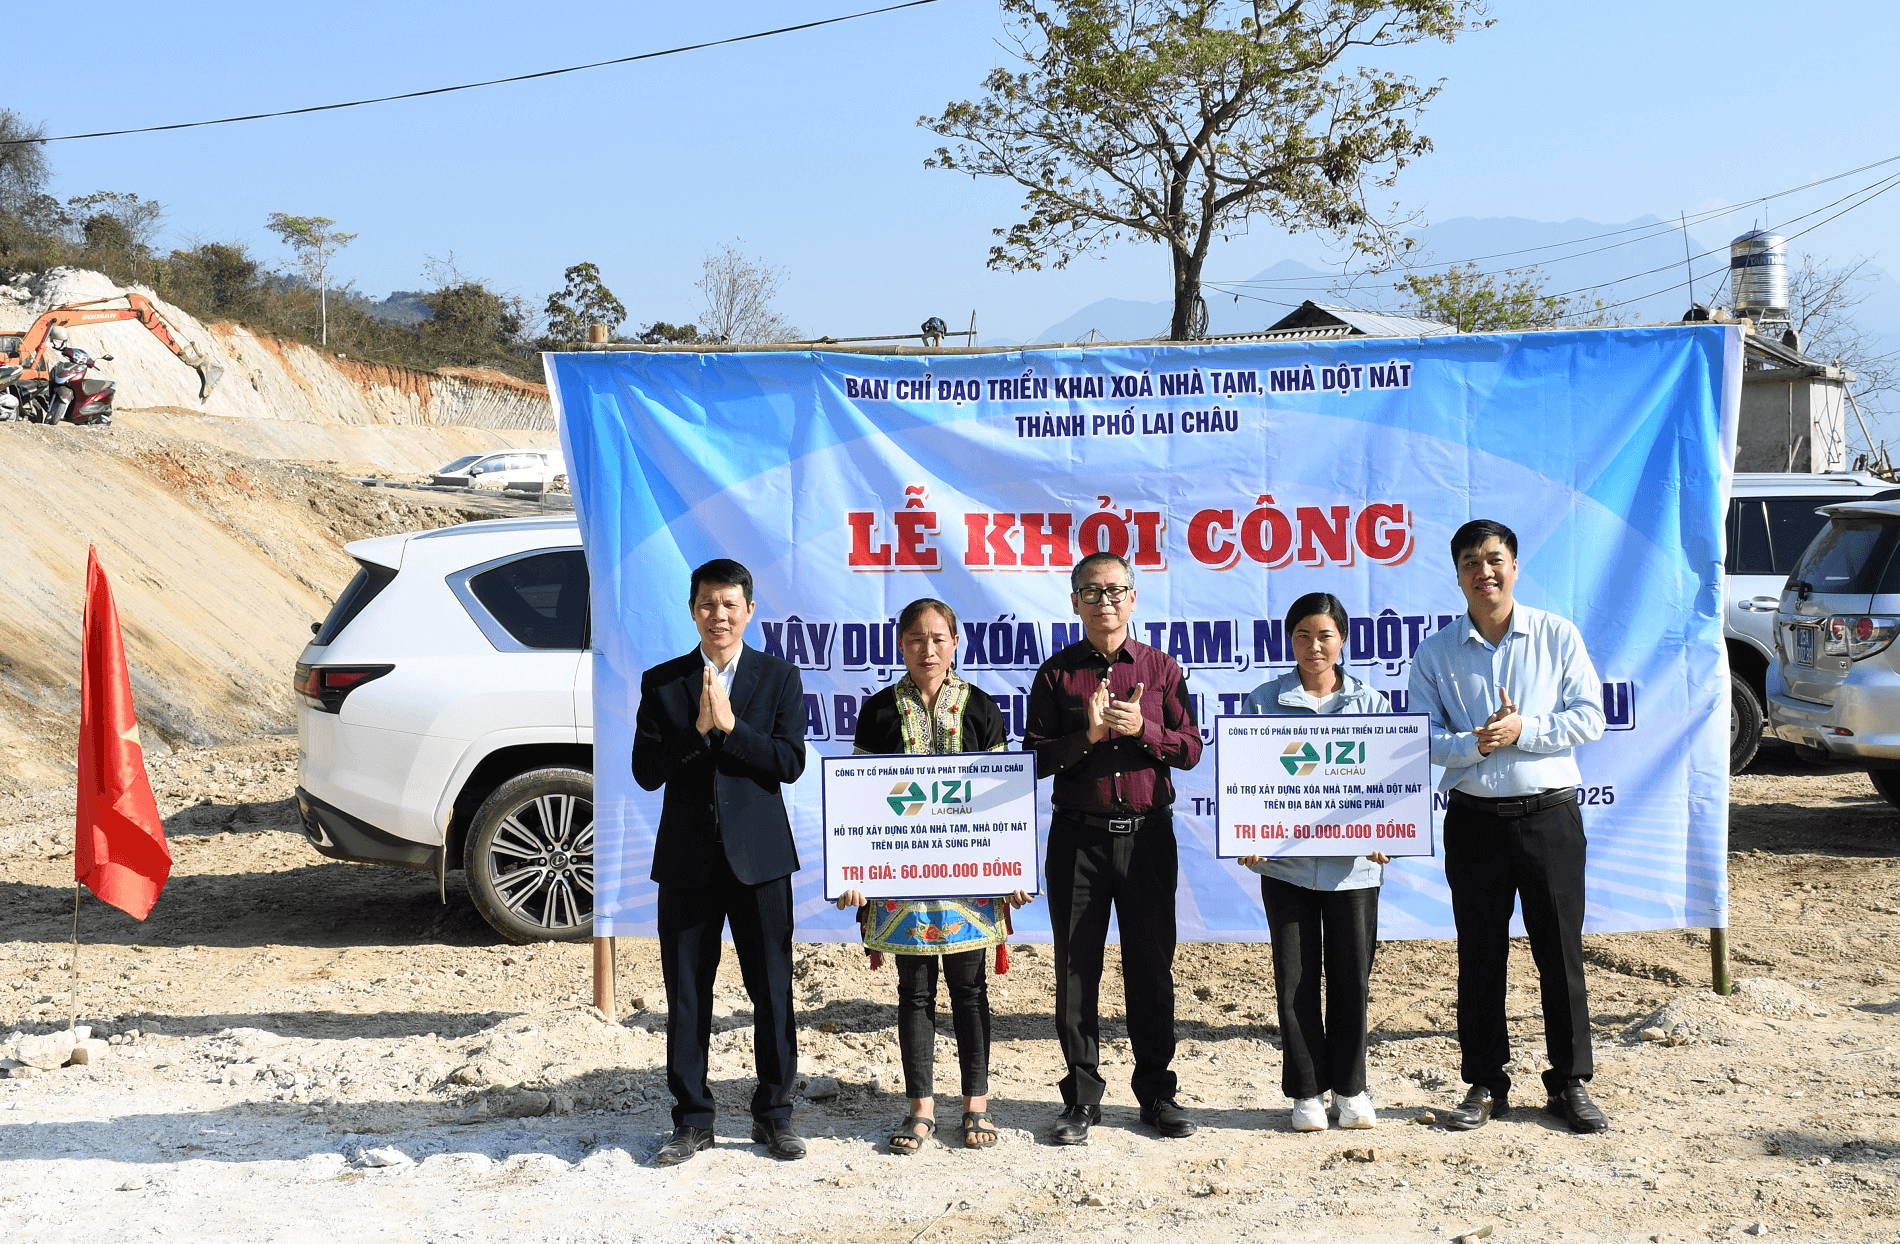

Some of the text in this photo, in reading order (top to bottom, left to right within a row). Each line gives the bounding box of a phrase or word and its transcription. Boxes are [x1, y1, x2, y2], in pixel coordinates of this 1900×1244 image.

[846, 360, 1411, 406] BAN CHỈ ĐẠO TRIỂN KHAI XOÁ NHÀ TẠM, NHÀ DỘT NÁT
[1015, 405, 1239, 438] THÀNH PHỐ LAI CHÂU
[848, 485, 1410, 568] LỄ KHỞI CÔNG
[761, 615, 831, 665] XÂY
[843, 617, 905, 676] DỰ
[963, 614, 1040, 665] XÓA
[1349, 608, 1425, 670] DỘT
[1228, 726, 1248, 736] CÔNG
[1260, 725, 1270, 735] CỔ
[1272, 726, 1292, 735] PHẦN
[1293, 726, 1308, 735] ĐẦU
[1310, 726, 1319, 735] TƯ
[1320, 726, 1330, 735] VÀ
[1331, 726, 1350, 735] PHÁT
[1352, 724, 1373, 735] TRIỂN
[1385, 726, 1397, 734] LAI
[1399, 726, 1418, 734] CHÂU
[1325, 741, 1365, 764] IZI
[835, 767, 855, 777] CÔNG
[857, 768, 865, 776] TY
[867, 766, 877, 776] CỔ
[878, 766, 898, 776] PHẦN
[900, 766, 914, 775] ĐẦU
[916, 767, 925, 775] TƯ
[927, 765, 936, 775] VÀ
[938, 765, 956, 774] PHÁT
[958, 763, 979, 774] TRIỂN
[1004, 763, 1024, 772] CHÂU
[932, 780, 972, 804] IZI
[1226, 783, 1422, 796] HỖ TRỢ XÂY DỰNG XÓA NHÀ TẠM, NHÀ DỘT NÁT
[1576, 786, 1615, 806] 025
[1264, 798, 1385, 811] TRÊN ĐỊA BÀN XÃ SÙNG PHÀI
[834, 821, 1027, 837] HỖ TRỢ XÂY DỰNG XÓA NHÀ TẠM, NHÀ DỘT NÁT
[1234, 819, 1416, 842] TRỊ GIÁ: 60.000.000 ĐỒNG
[871, 837, 991, 851] TRÊN ĐỊA BÀN XÃ SÙNG PHÀI
[842, 857, 1022, 883] TRỊ GIÁ: 60.000.000 ĐỒNG
